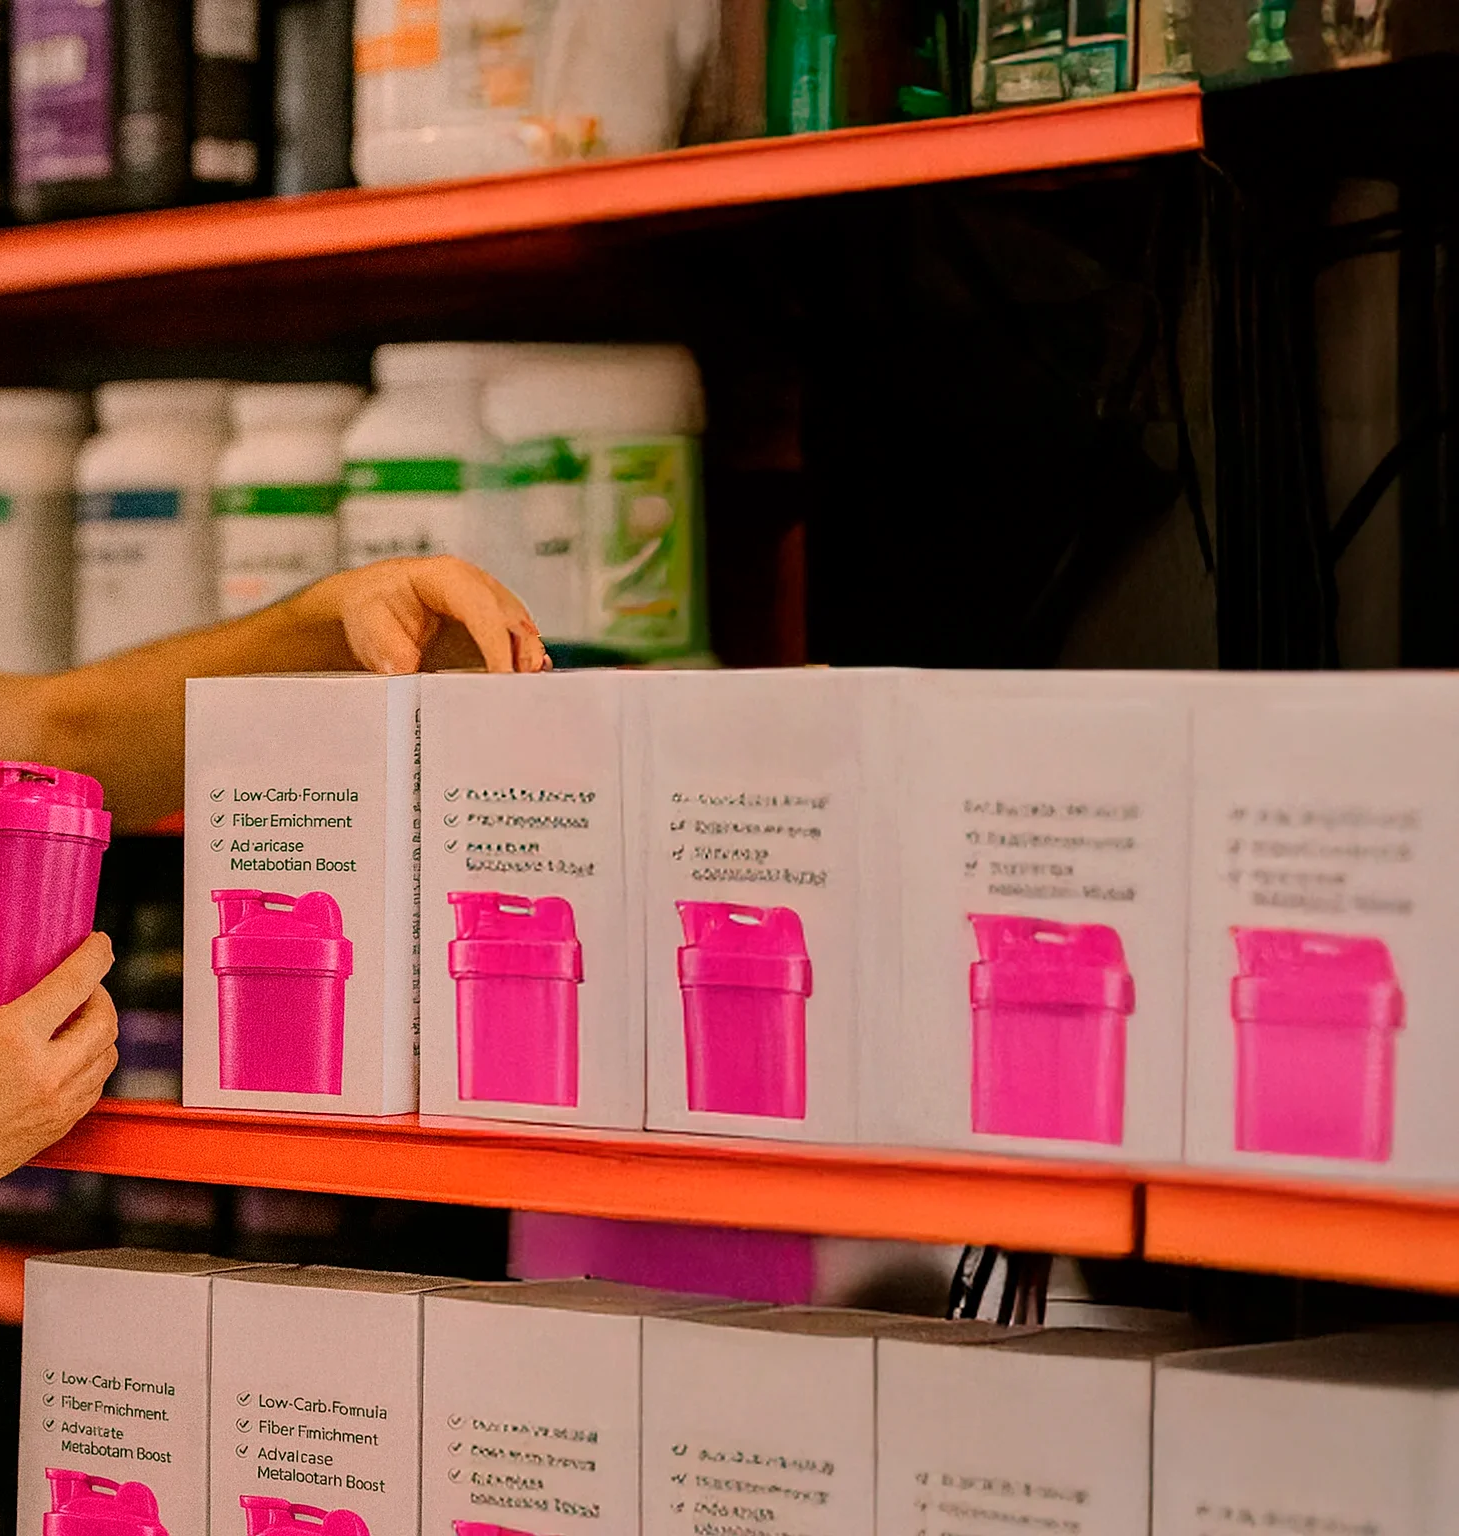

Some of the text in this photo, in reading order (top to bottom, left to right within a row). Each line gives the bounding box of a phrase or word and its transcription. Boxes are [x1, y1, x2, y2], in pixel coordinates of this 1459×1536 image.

[233, 813, 268, 827] Fiber
[316, 858, 356, 872] Boost
[260, 1420, 294, 1436] Fiber
[137, 1447, 171, 1463] Boost
[346, 1475, 385, 1493] Boost
